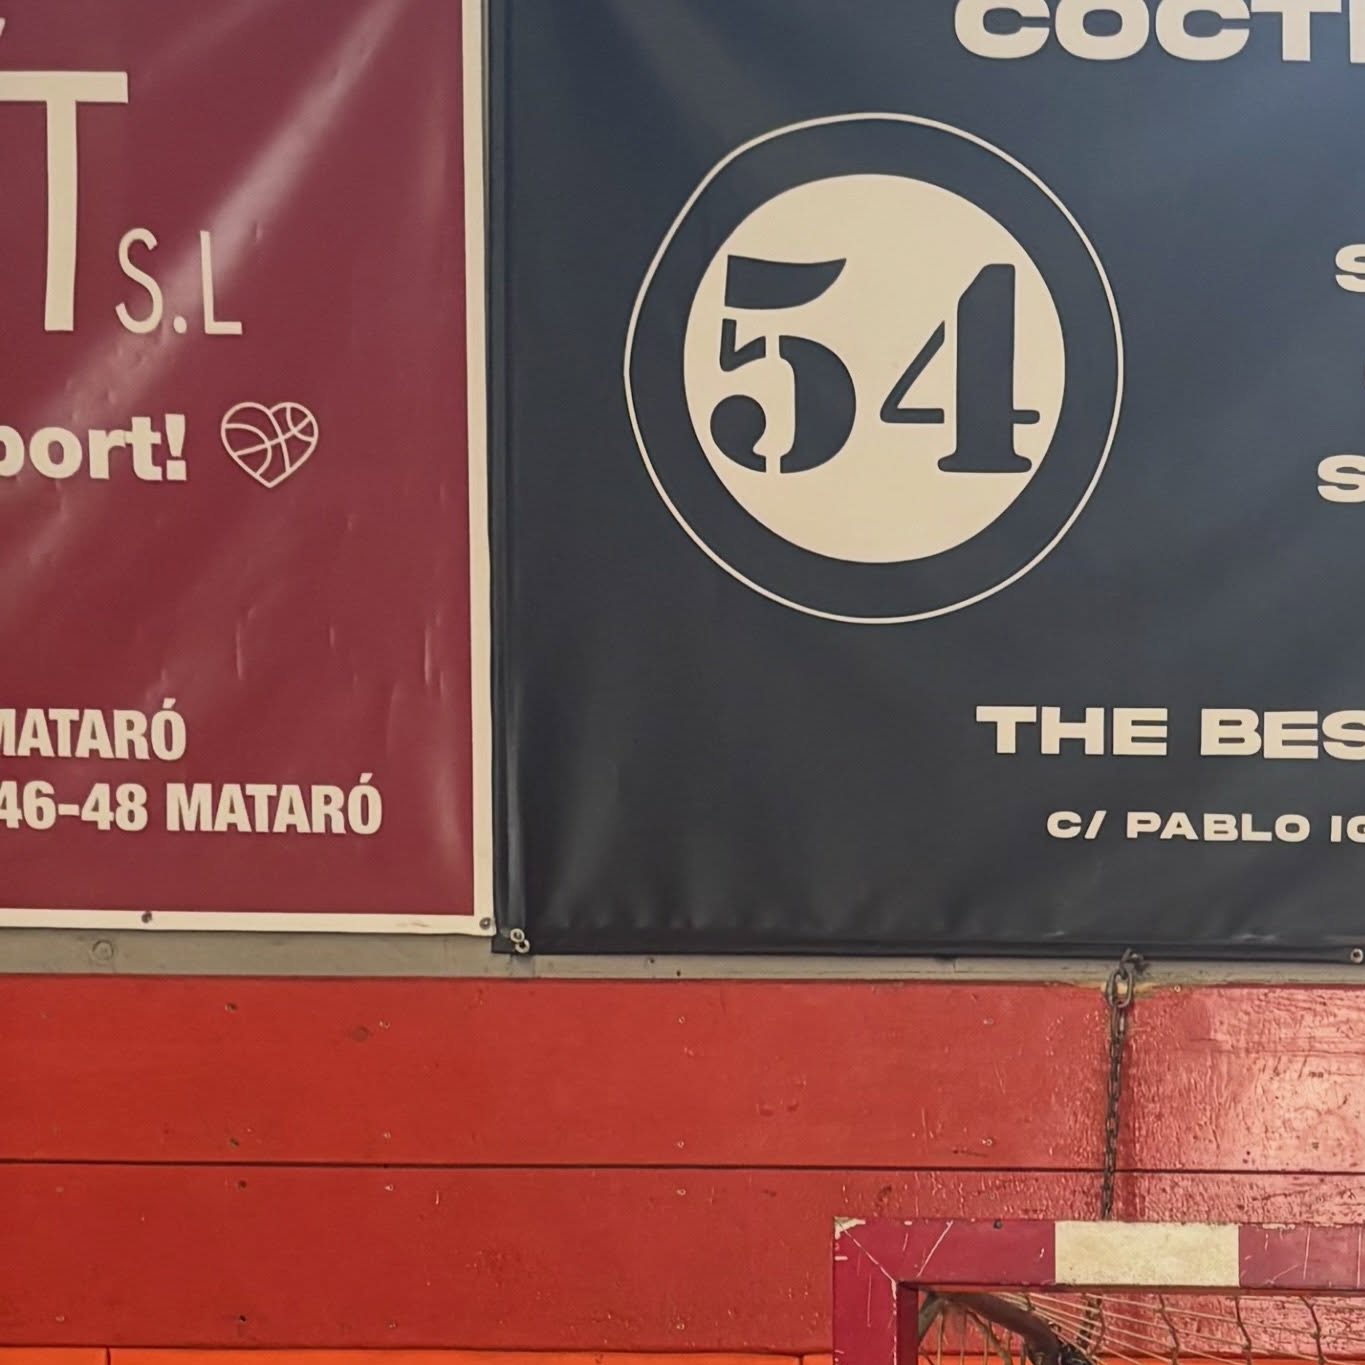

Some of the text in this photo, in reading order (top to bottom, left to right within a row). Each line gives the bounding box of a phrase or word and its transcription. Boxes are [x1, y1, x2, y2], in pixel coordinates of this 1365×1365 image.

[115, 228, 243, 336] S.L
[709, 254, 1041, 475] 54
[977, 706, 1168, 756] THE
[166, 773, 383, 835] MATARÓ
[1046, 810, 1106, 841] C/
[1127, 812, 1311, 842] PABLO
